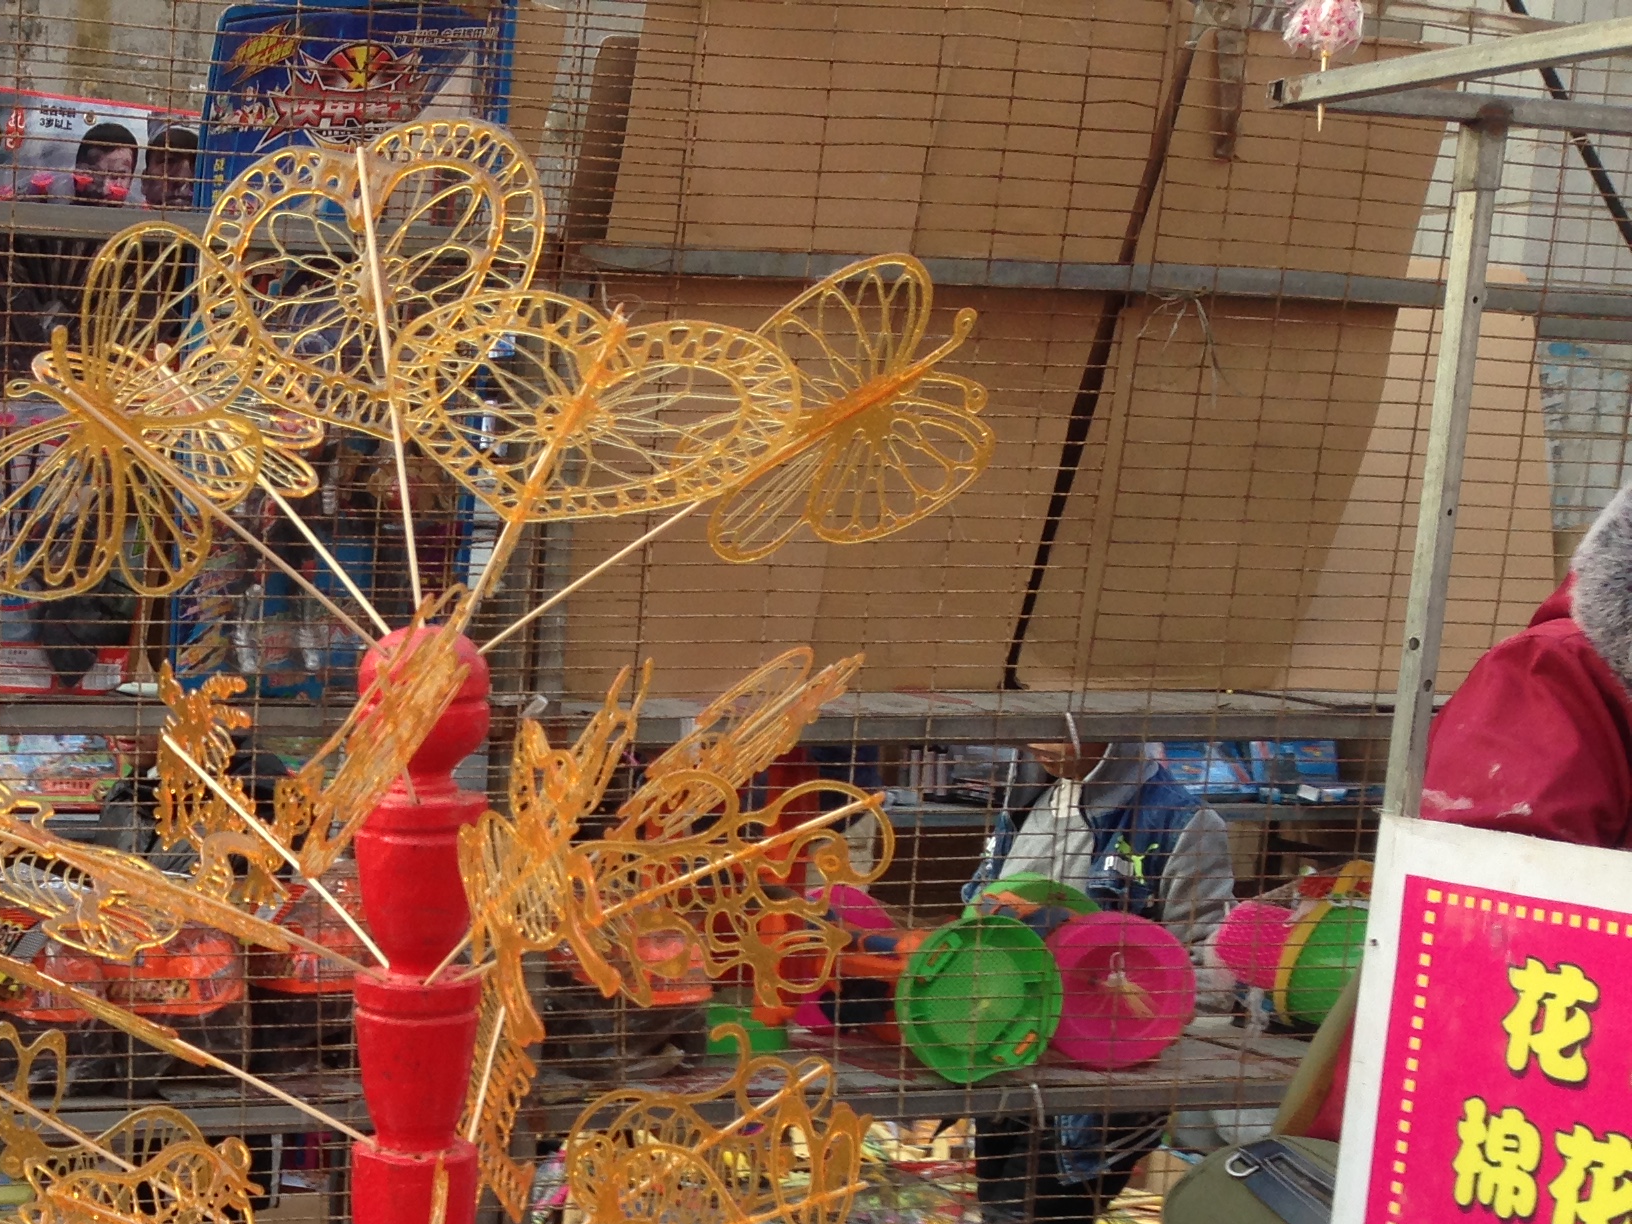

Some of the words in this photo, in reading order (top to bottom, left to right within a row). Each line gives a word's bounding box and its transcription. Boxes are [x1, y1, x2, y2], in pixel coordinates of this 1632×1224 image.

[40, 117, 72, 131] 3岁以上
[1502, 955, 1599, 1083] 花
